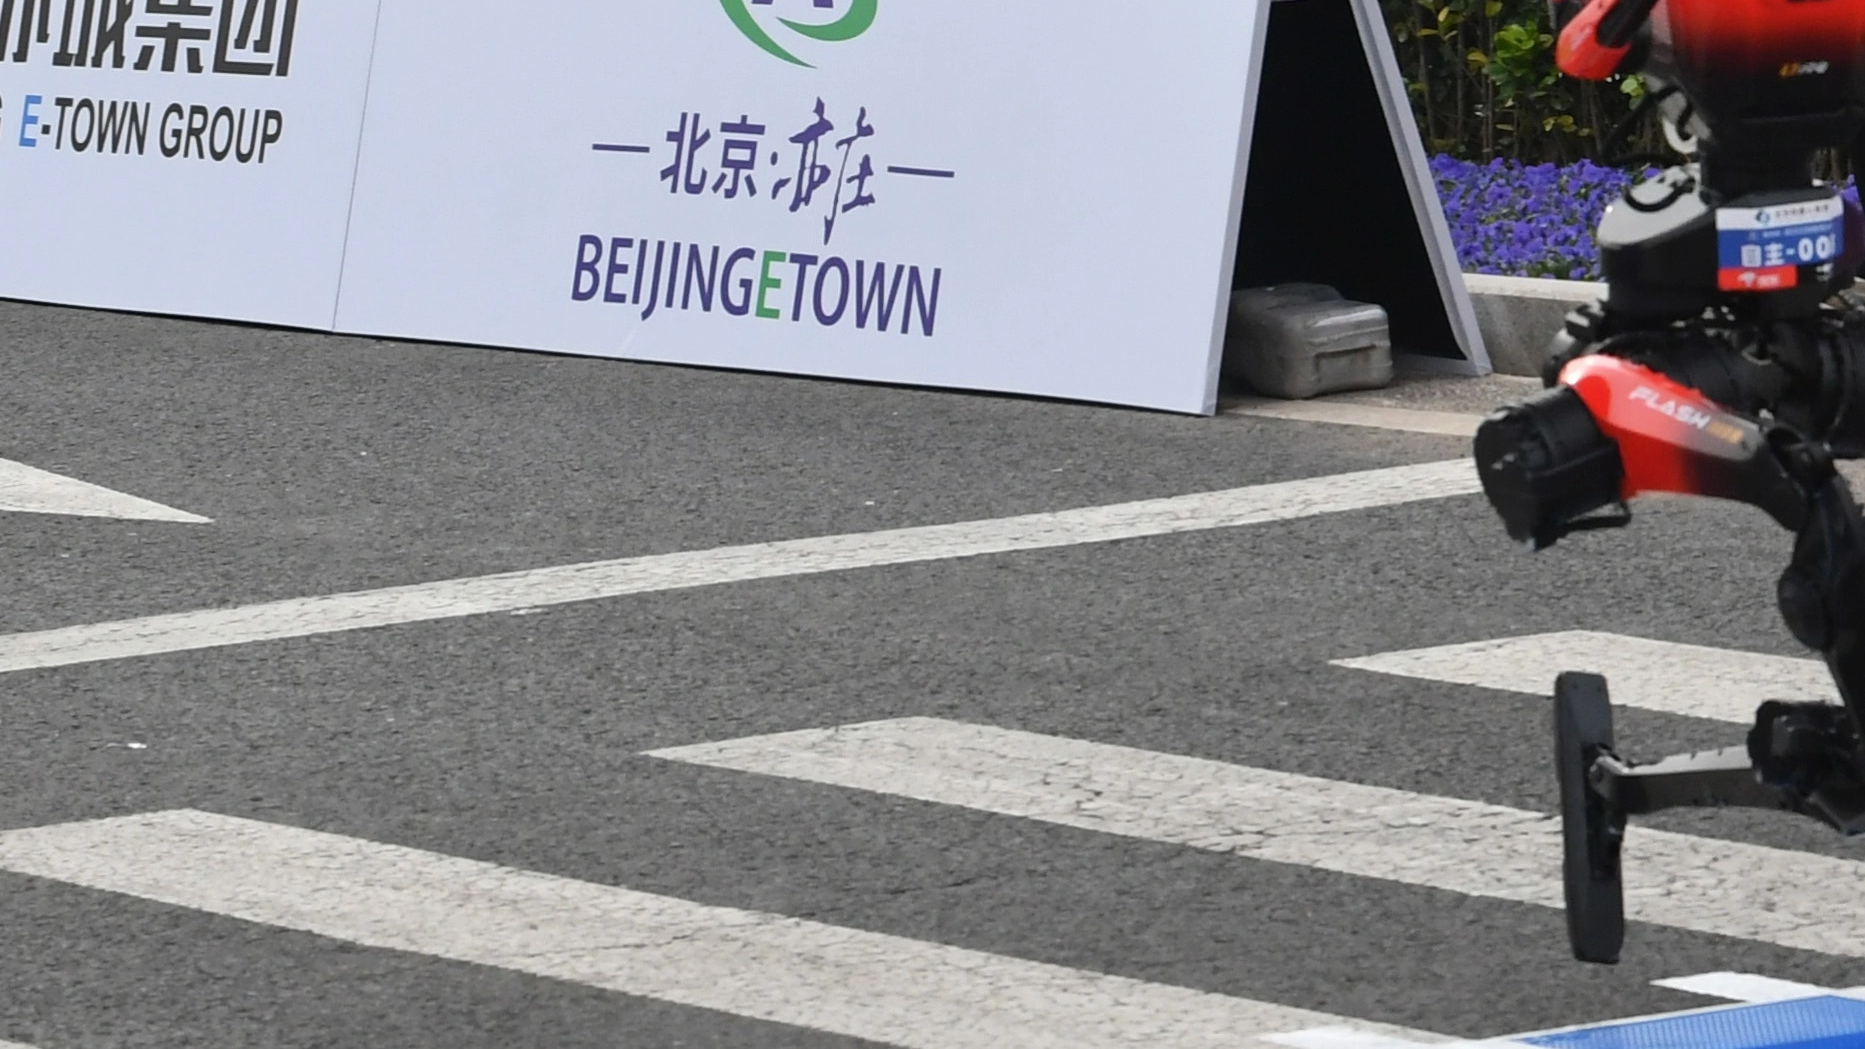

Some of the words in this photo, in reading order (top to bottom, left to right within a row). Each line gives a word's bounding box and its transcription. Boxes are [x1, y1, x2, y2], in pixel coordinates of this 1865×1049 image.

[19, 94, 151, 156] E-TOWN
[159, 102, 283, 164] GROUP
[571, 234, 942, 338] BEIJINGETOWN
